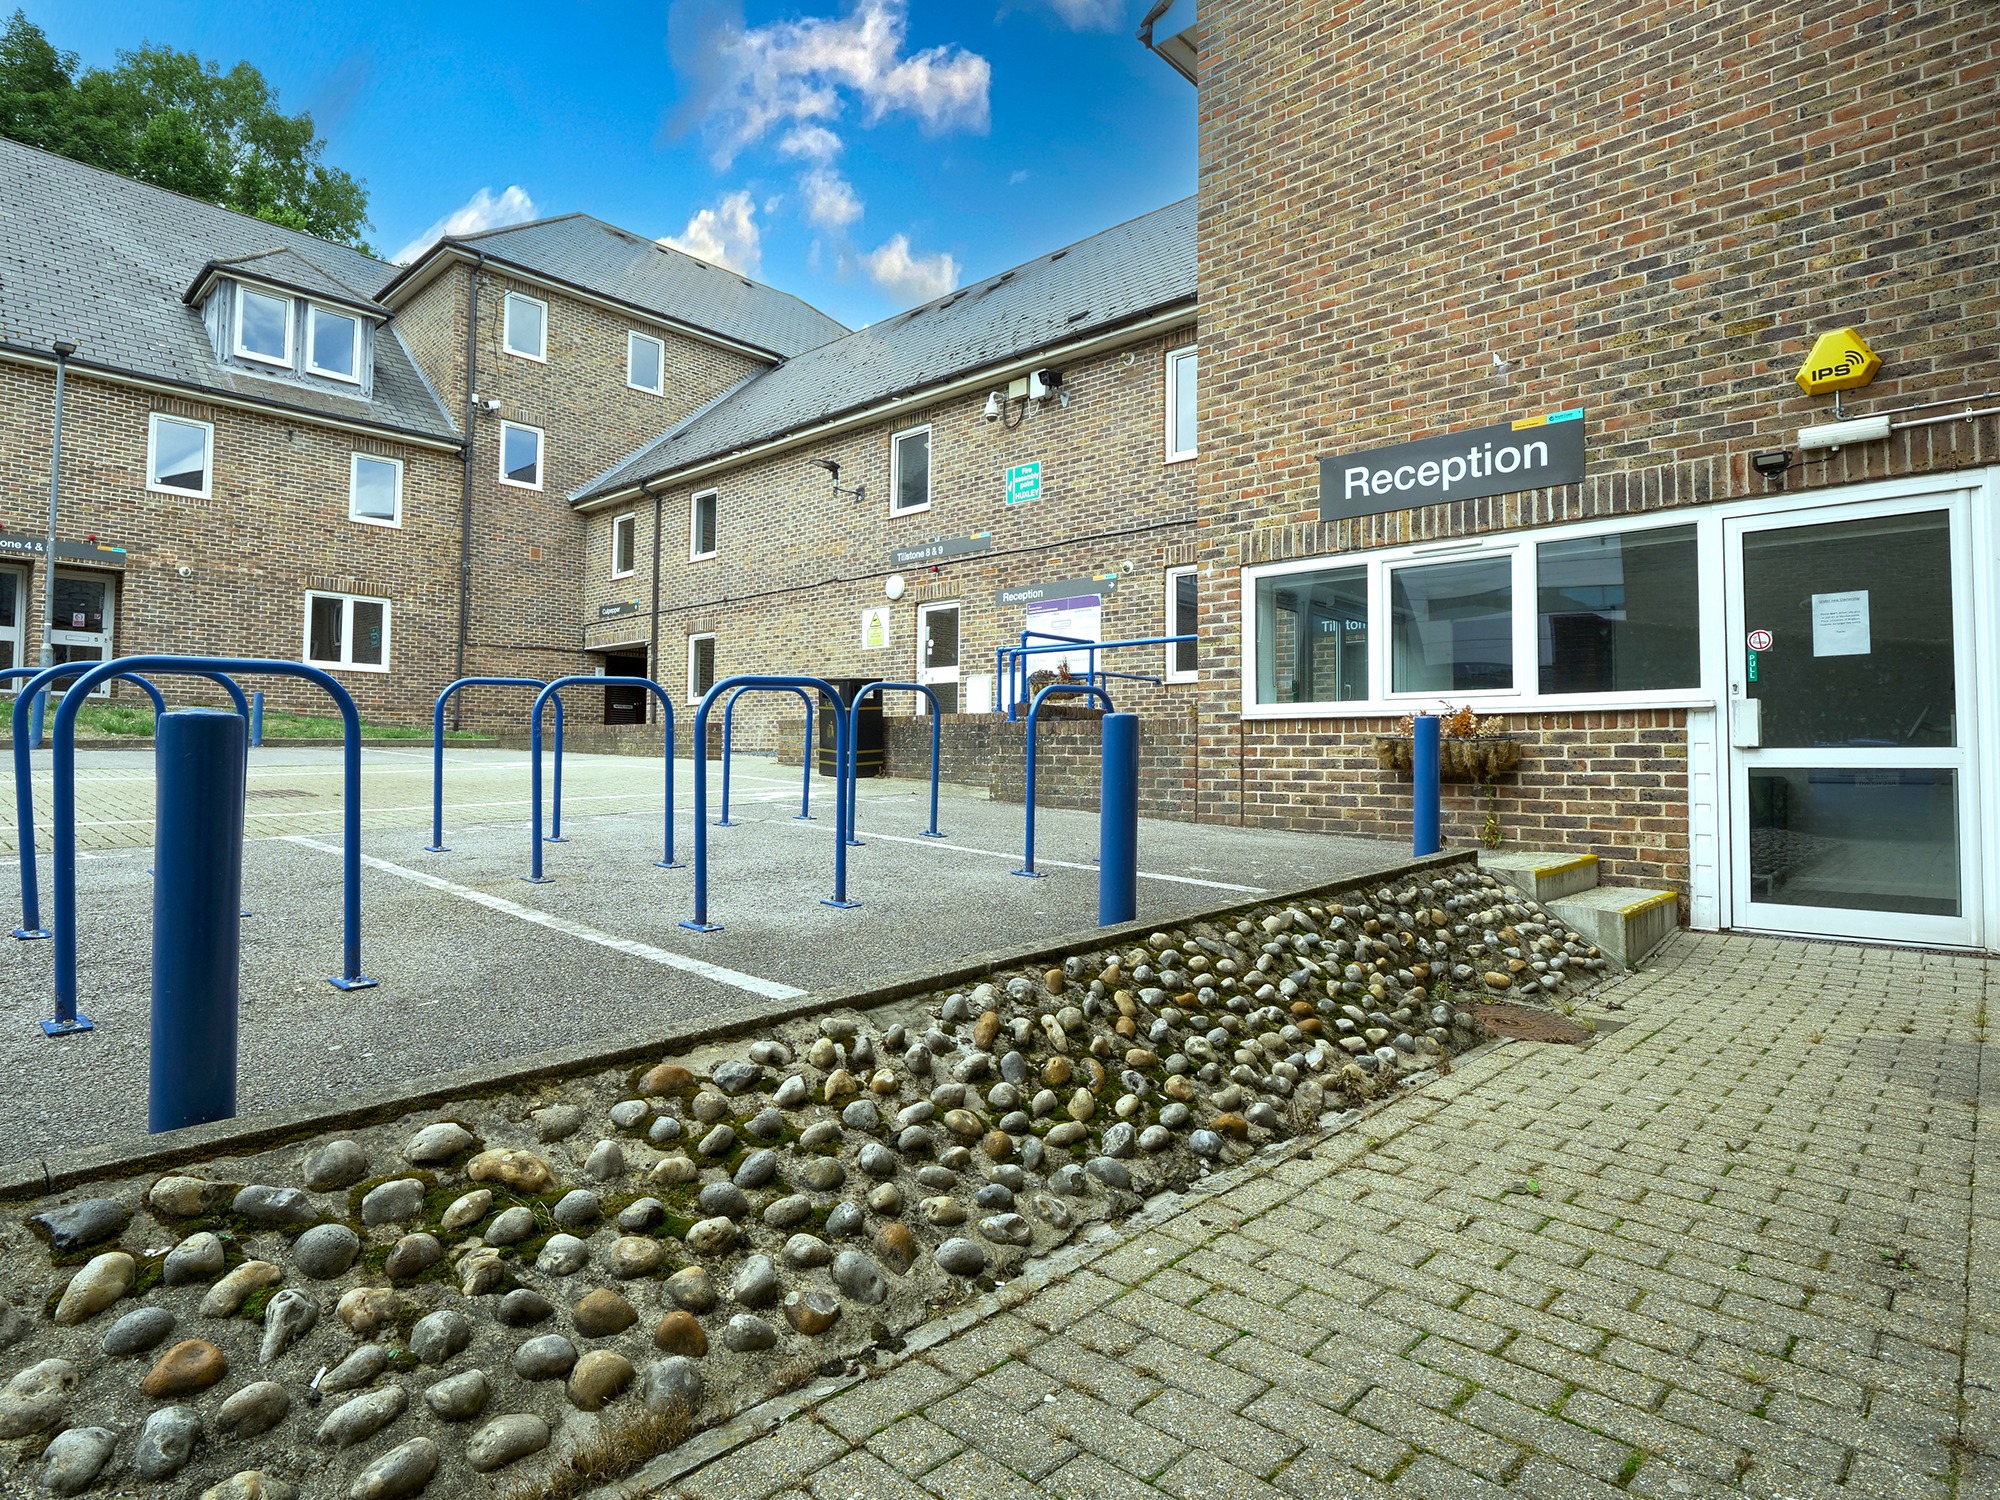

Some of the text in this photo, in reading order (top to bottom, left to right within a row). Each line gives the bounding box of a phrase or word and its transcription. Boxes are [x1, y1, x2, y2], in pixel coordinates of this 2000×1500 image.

[1811, 363, 1851, 382] IPS
[1344, 440, 1549, 500] Reception
[1020, 480, 1034, 490] point
[1015, 488, 1039, 500] HUXLEY
[0, 540, 22, 549] one
[24, 541, 32, 550] 4
[34, 542, 43, 552] &
[925, 547, 931, 557] 8
[931, 546, 938, 556] &
[938, 545, 944, 555] 9
[1002, 588, 1044, 602] Reception
[1321, 619, 1367, 632] Tilton
